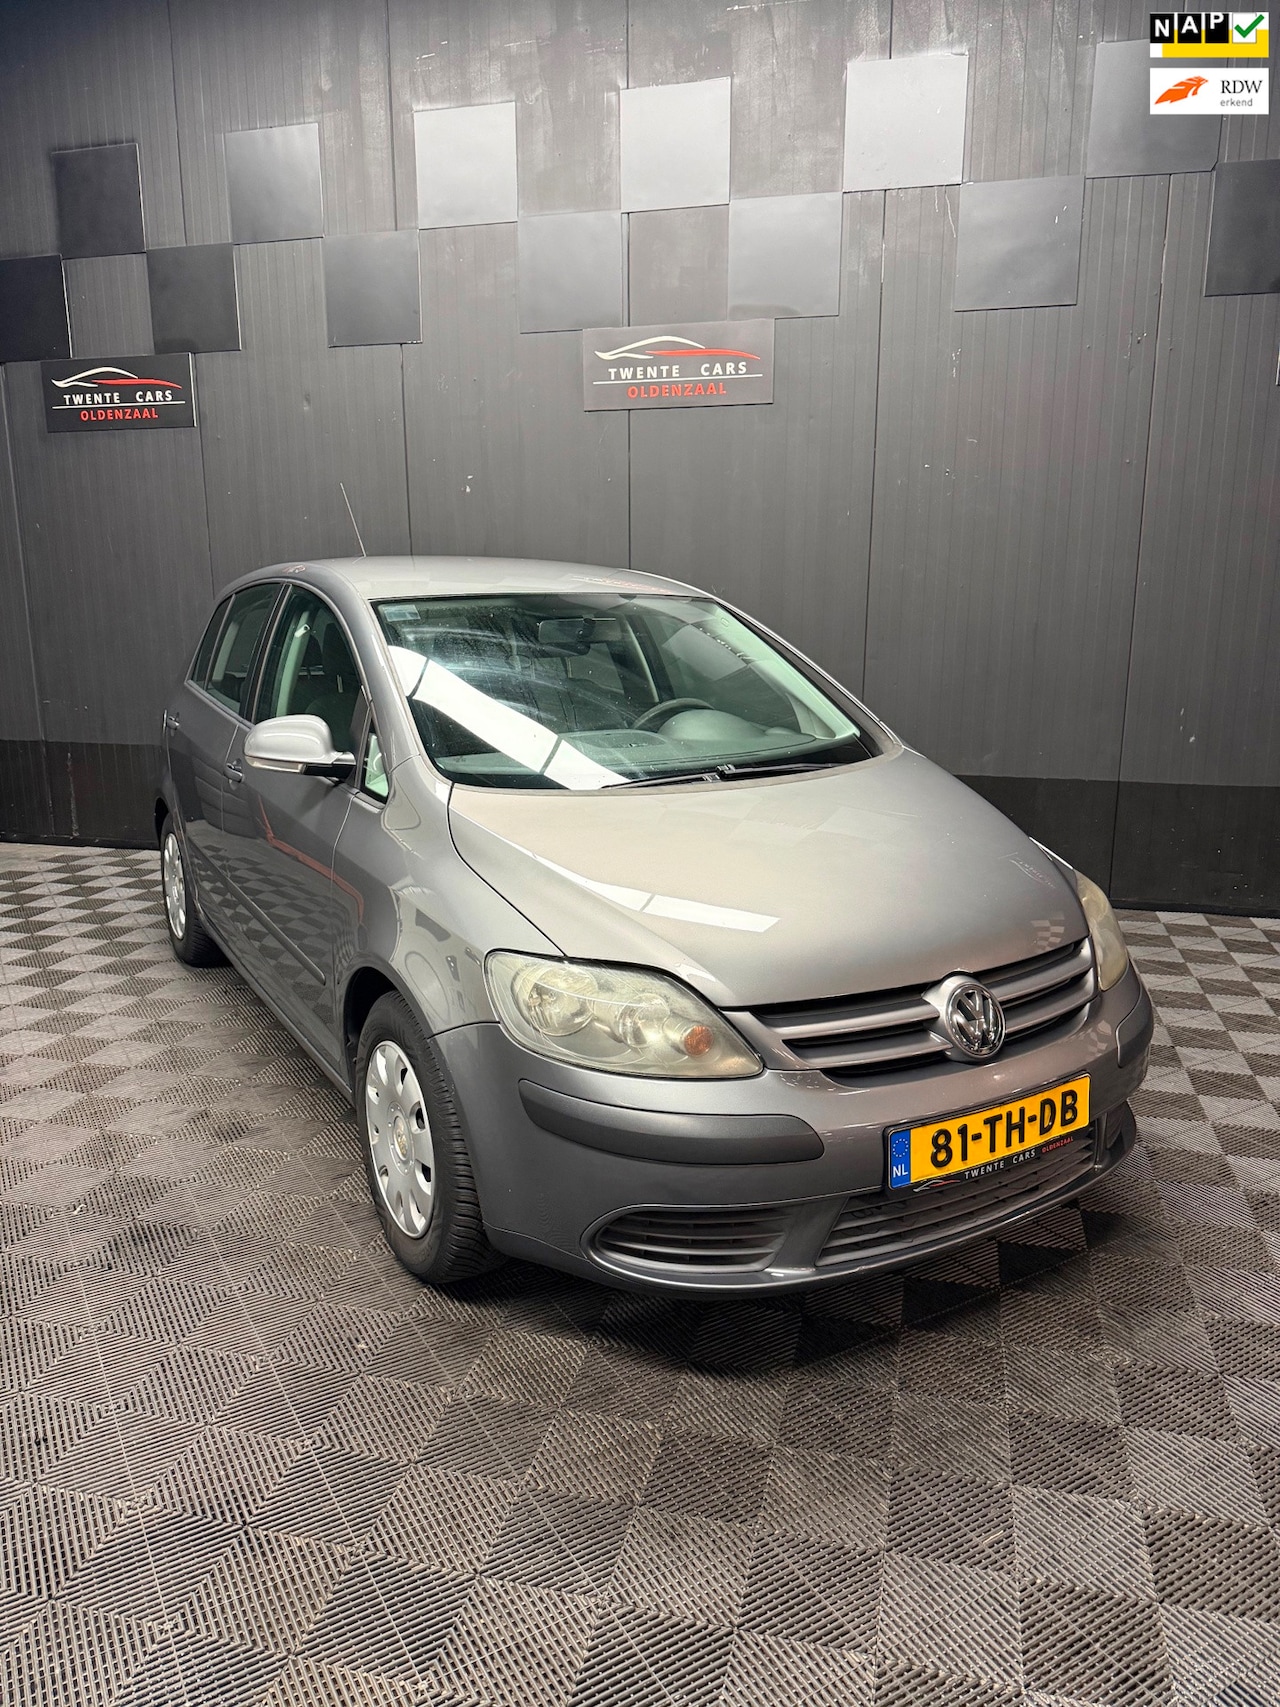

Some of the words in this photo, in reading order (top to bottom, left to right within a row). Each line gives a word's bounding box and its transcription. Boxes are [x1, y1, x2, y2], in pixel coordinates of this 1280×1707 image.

[608, 364, 681, 380] TWENTE
[700, 361, 748, 377] CARS
[63, 392, 121, 406] TWENTE
[135, 389, 173, 403] CARS
[627, 382, 727, 399] OLDENZAAL
[80, 407, 159, 422] OLDENZAAL
[930, 1089, 1078, 1168] 81-TH-DB
[964, 1161, 1006, 1180] TWENTE
[1012, 1149, 1036, 1164] CARS
[1041, 1136, 1074, 1153] OLDENZAAL
[892, 1164, 909, 1178] NL
